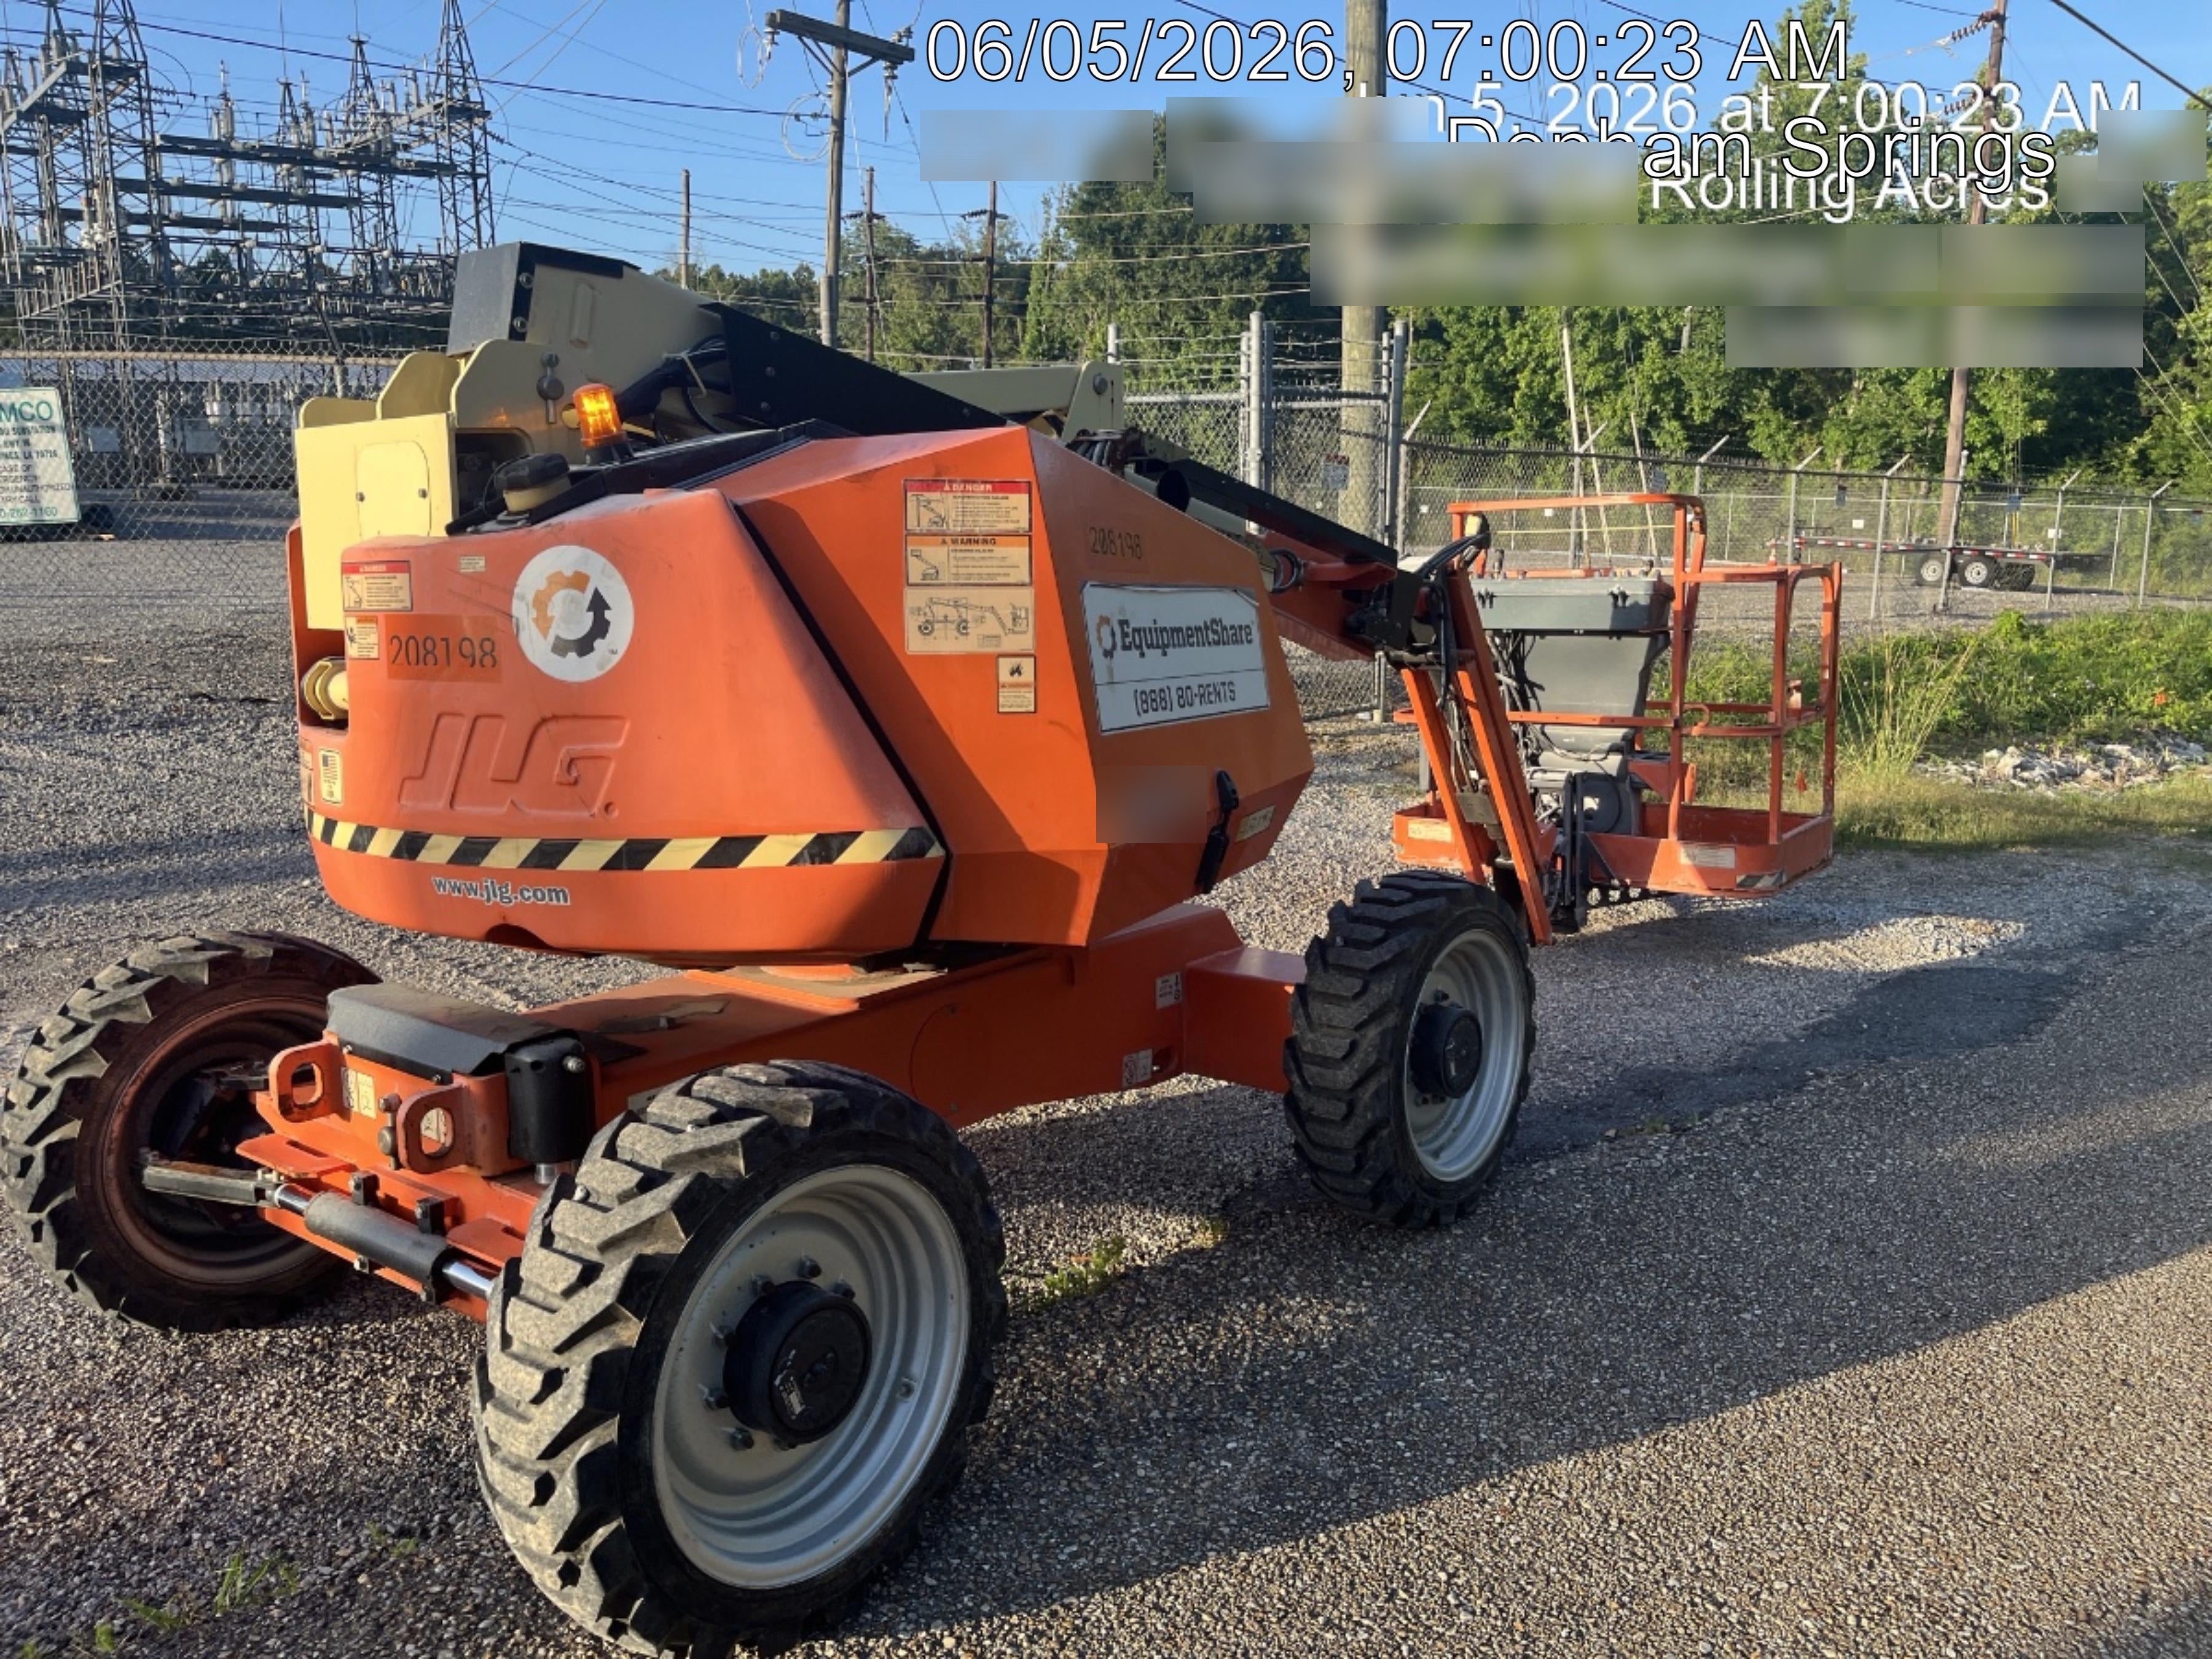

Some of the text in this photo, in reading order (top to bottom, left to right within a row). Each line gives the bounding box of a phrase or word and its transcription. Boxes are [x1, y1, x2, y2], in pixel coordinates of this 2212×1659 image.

[390, 635, 497, 669] 208198
[1117, 618, 1253, 658] EquipmentShare
[1134, 681, 1236, 716] (888) 80-RENTS
[431, 875, 570, 906] www.jlg.com
